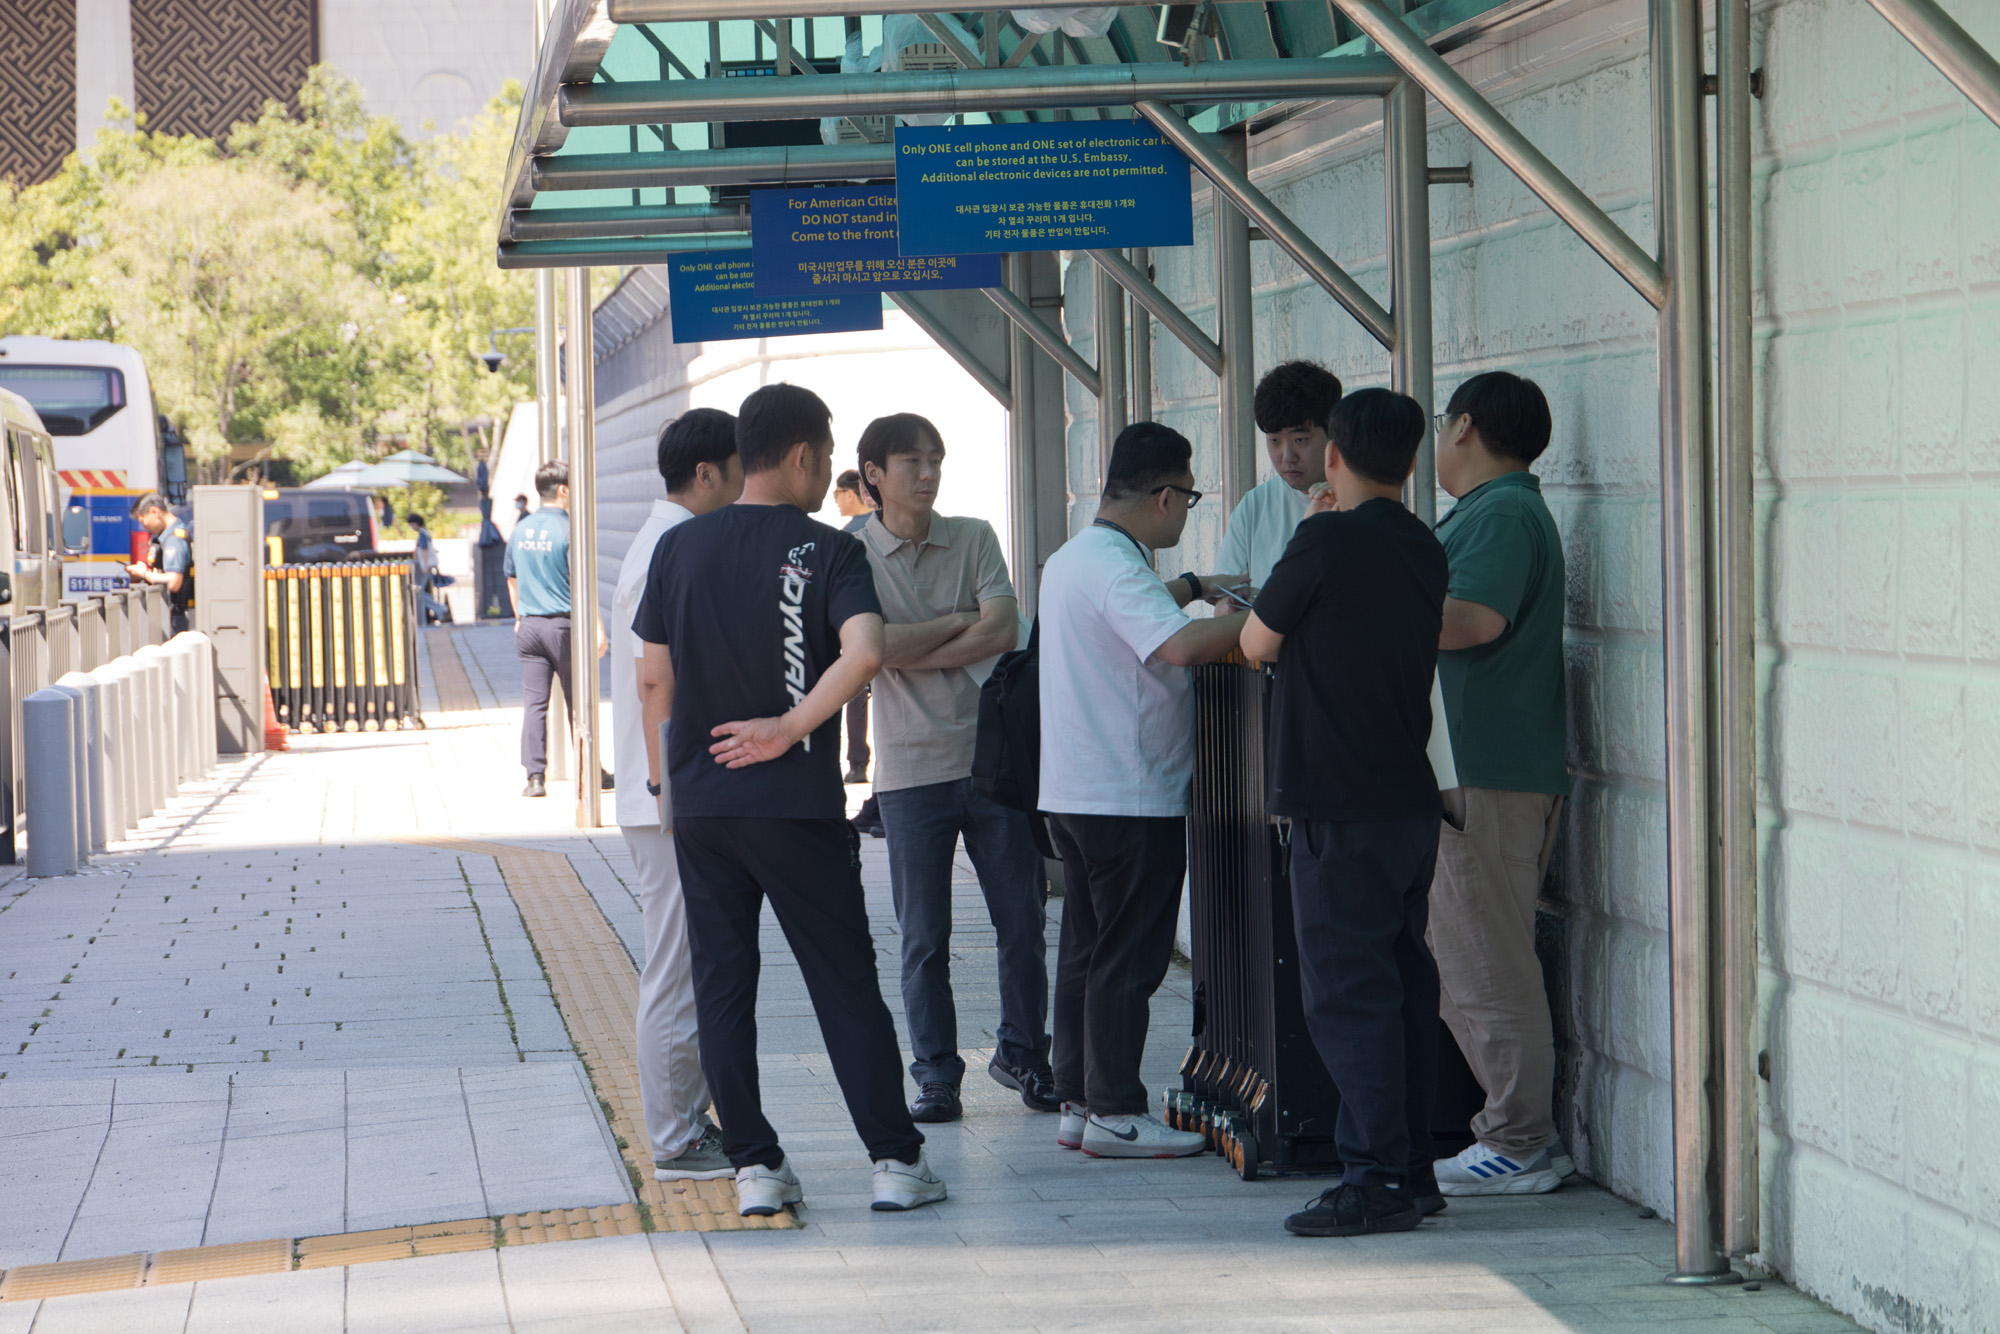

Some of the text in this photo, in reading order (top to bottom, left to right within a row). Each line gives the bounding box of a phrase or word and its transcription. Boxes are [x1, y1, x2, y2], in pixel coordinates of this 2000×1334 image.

[902, 144, 927, 156] Only
[928, 143, 952, 154] ONE
[954, 142, 972, 153] cell
[974, 142, 1008, 154] phone
[1010, 140, 1030, 151] and
[1032, 139, 1055, 150] ONE
[1058, 139, 1074, 149] set
[1075, 138, 1087, 149] of
[1088, 136, 1141, 148] electronic
[1142, 138, 1159, 146] car
[955, 152, 1132, 168] can be stored at the U.S. Embassy.
[921, 164, 1168, 183] Additional electronic devices are not permitted.
[788, 198, 808, 209] For
[809, 197, 865, 209] American
[955, 198, 1136, 214] 대사관 입장시 보관 가능한 물품은 휴대전화 1개와
[802, 211, 897, 226] DO NOT stand in
[998, 213, 1096, 226] 차 열쇠 꾸러미 1개 입니다.
[791, 231, 825, 242] Come
[827, 231, 840, 241] to
[842, 229, 862, 240] the
[864, 228, 894, 240] front
[985, 226, 1110, 240] 기타 전자 물품은 반입이 안됩니다.
[680, 264, 696, 272] Only
[697, 262, 713, 272] ONE
[714, 262, 727, 271] cell
[727, 261, 751, 270] phone
[798, 256, 957, 273] 미국시민업무를 위해 오신 분은 이곳에
[812, 270, 943, 285] 줄서지 마시고 앞으로 오십시오.
[518, 540, 553, 552] POLICE
